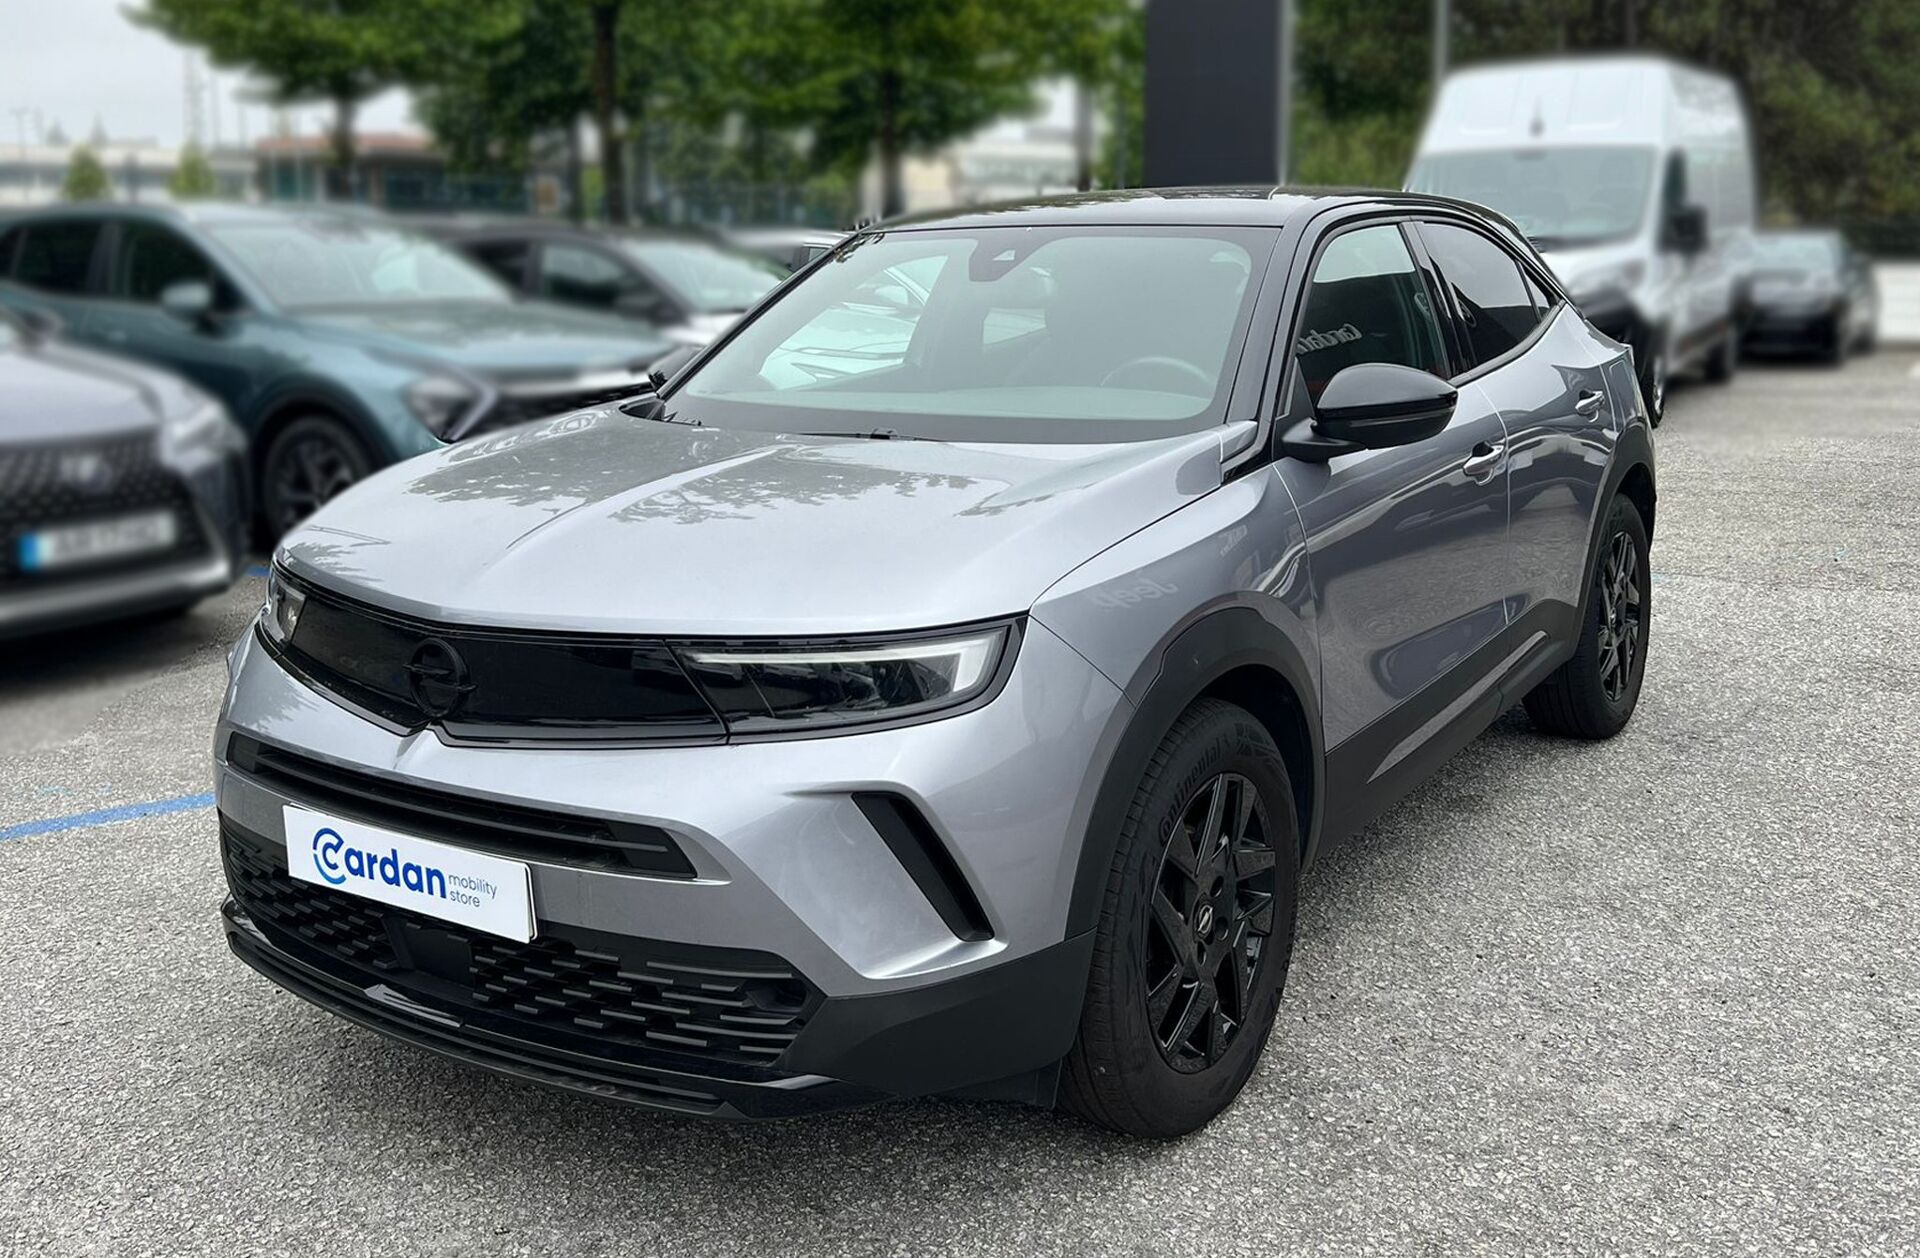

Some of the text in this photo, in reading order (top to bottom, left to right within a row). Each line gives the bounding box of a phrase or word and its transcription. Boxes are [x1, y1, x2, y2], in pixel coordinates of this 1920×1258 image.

[313, 828, 446, 898] Cardan
[449, 873, 497, 899] mobility
[450, 893, 480, 907] store
